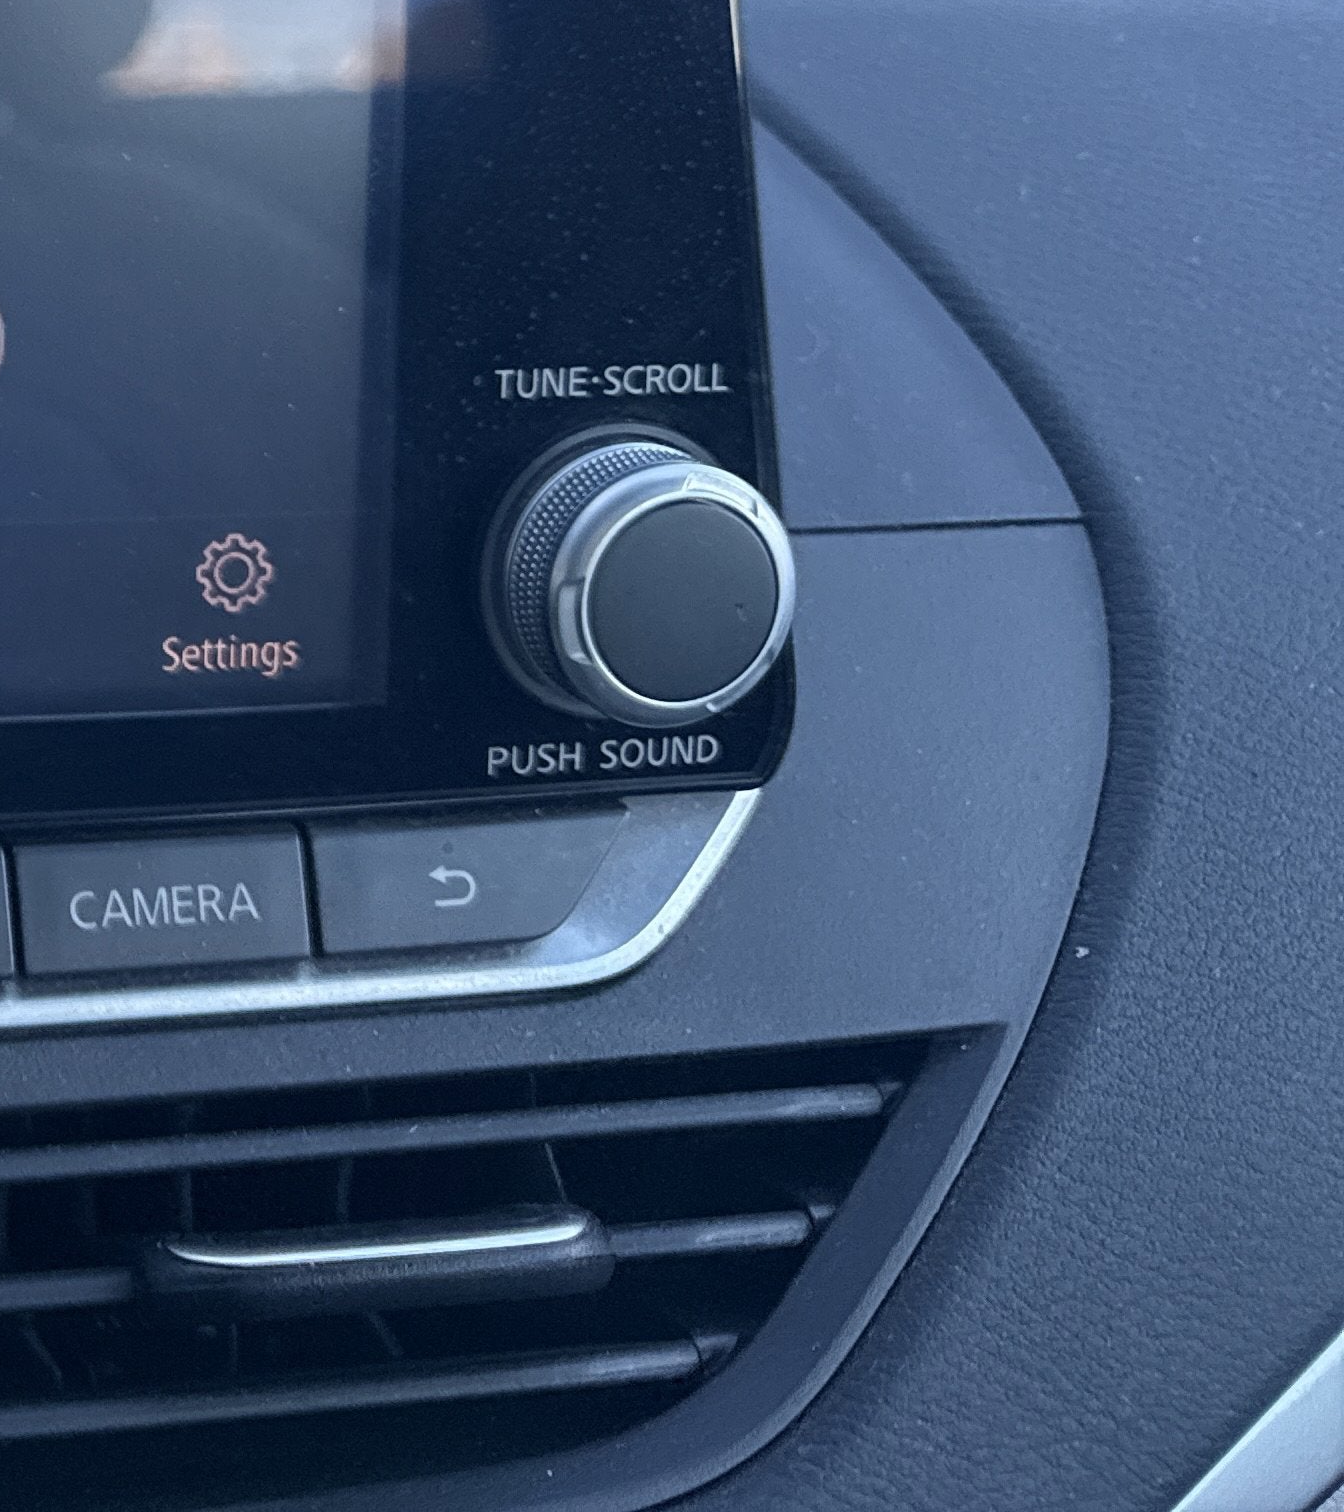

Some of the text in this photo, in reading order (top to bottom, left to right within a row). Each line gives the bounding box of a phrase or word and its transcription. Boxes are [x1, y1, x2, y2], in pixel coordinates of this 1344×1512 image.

[161, 635, 301, 678] Settings
[487, 735, 719, 777] PUSH SOUND
[68, 882, 260, 931] CAMERA
